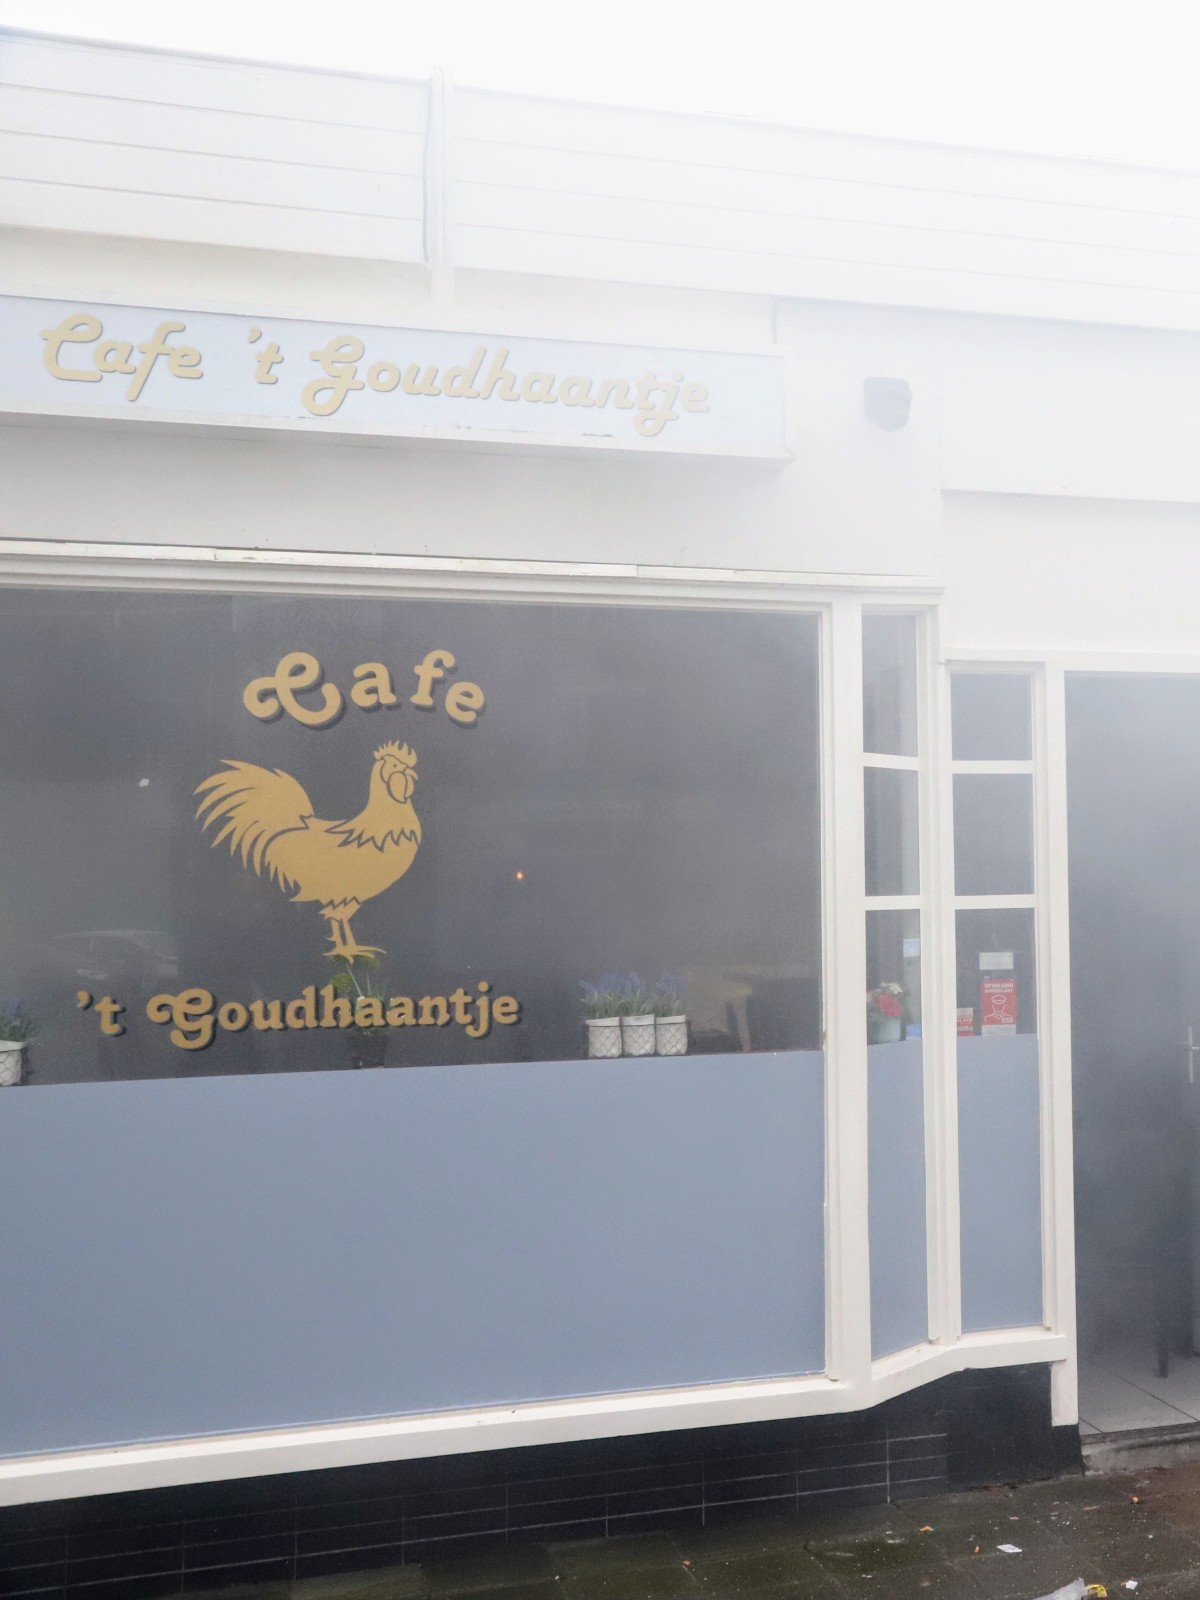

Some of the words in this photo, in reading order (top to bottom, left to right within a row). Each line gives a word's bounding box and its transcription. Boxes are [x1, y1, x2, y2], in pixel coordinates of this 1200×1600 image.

[40, 313, 204, 402] Cafe
[248, 328, 284, 385] 't
[301, 335, 711, 437] Goudhaantje
[243, 650, 487, 727] Cafe
[76, 990, 127, 1036] 't
[146, 981, 523, 1050] Goudhaantje
